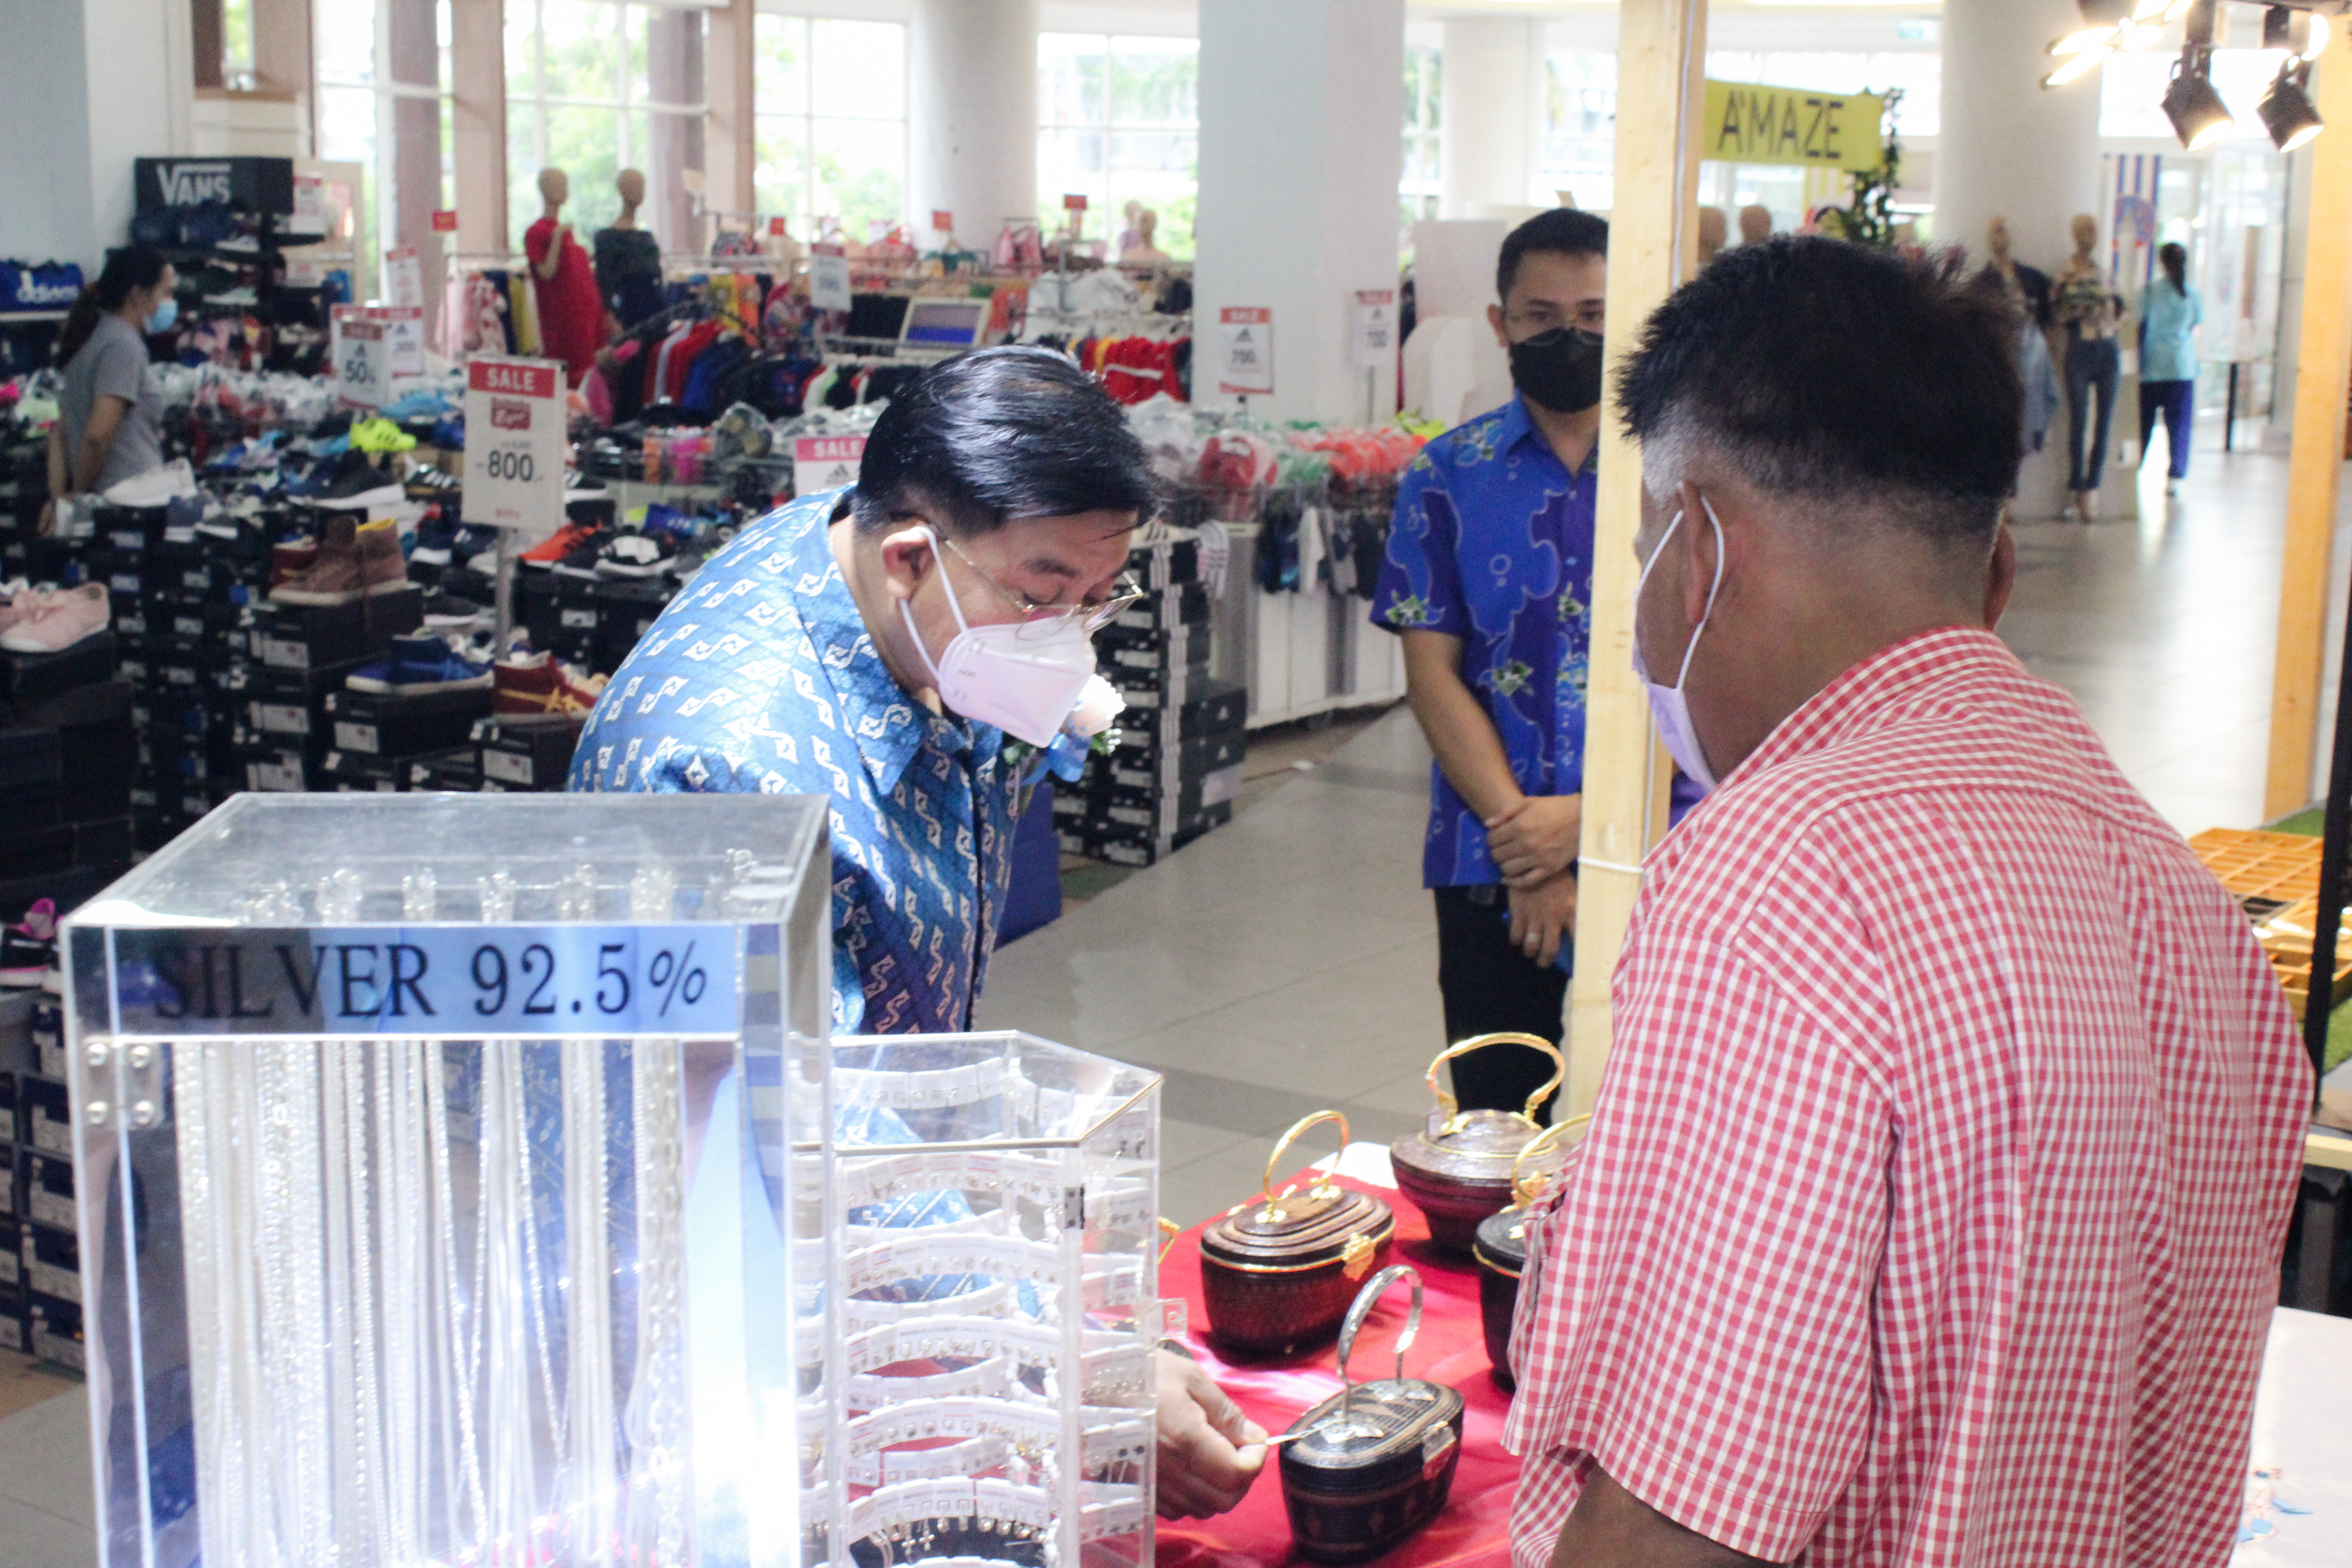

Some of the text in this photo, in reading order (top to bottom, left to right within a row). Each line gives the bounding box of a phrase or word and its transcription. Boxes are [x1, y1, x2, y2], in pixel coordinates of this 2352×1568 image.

[157, 163, 231, 204] VANS
[487, 367, 535, 392] SALE
[813, 440, 862, 458] SALE
[154, 939, 707, 1018] SILVER 92.5%
